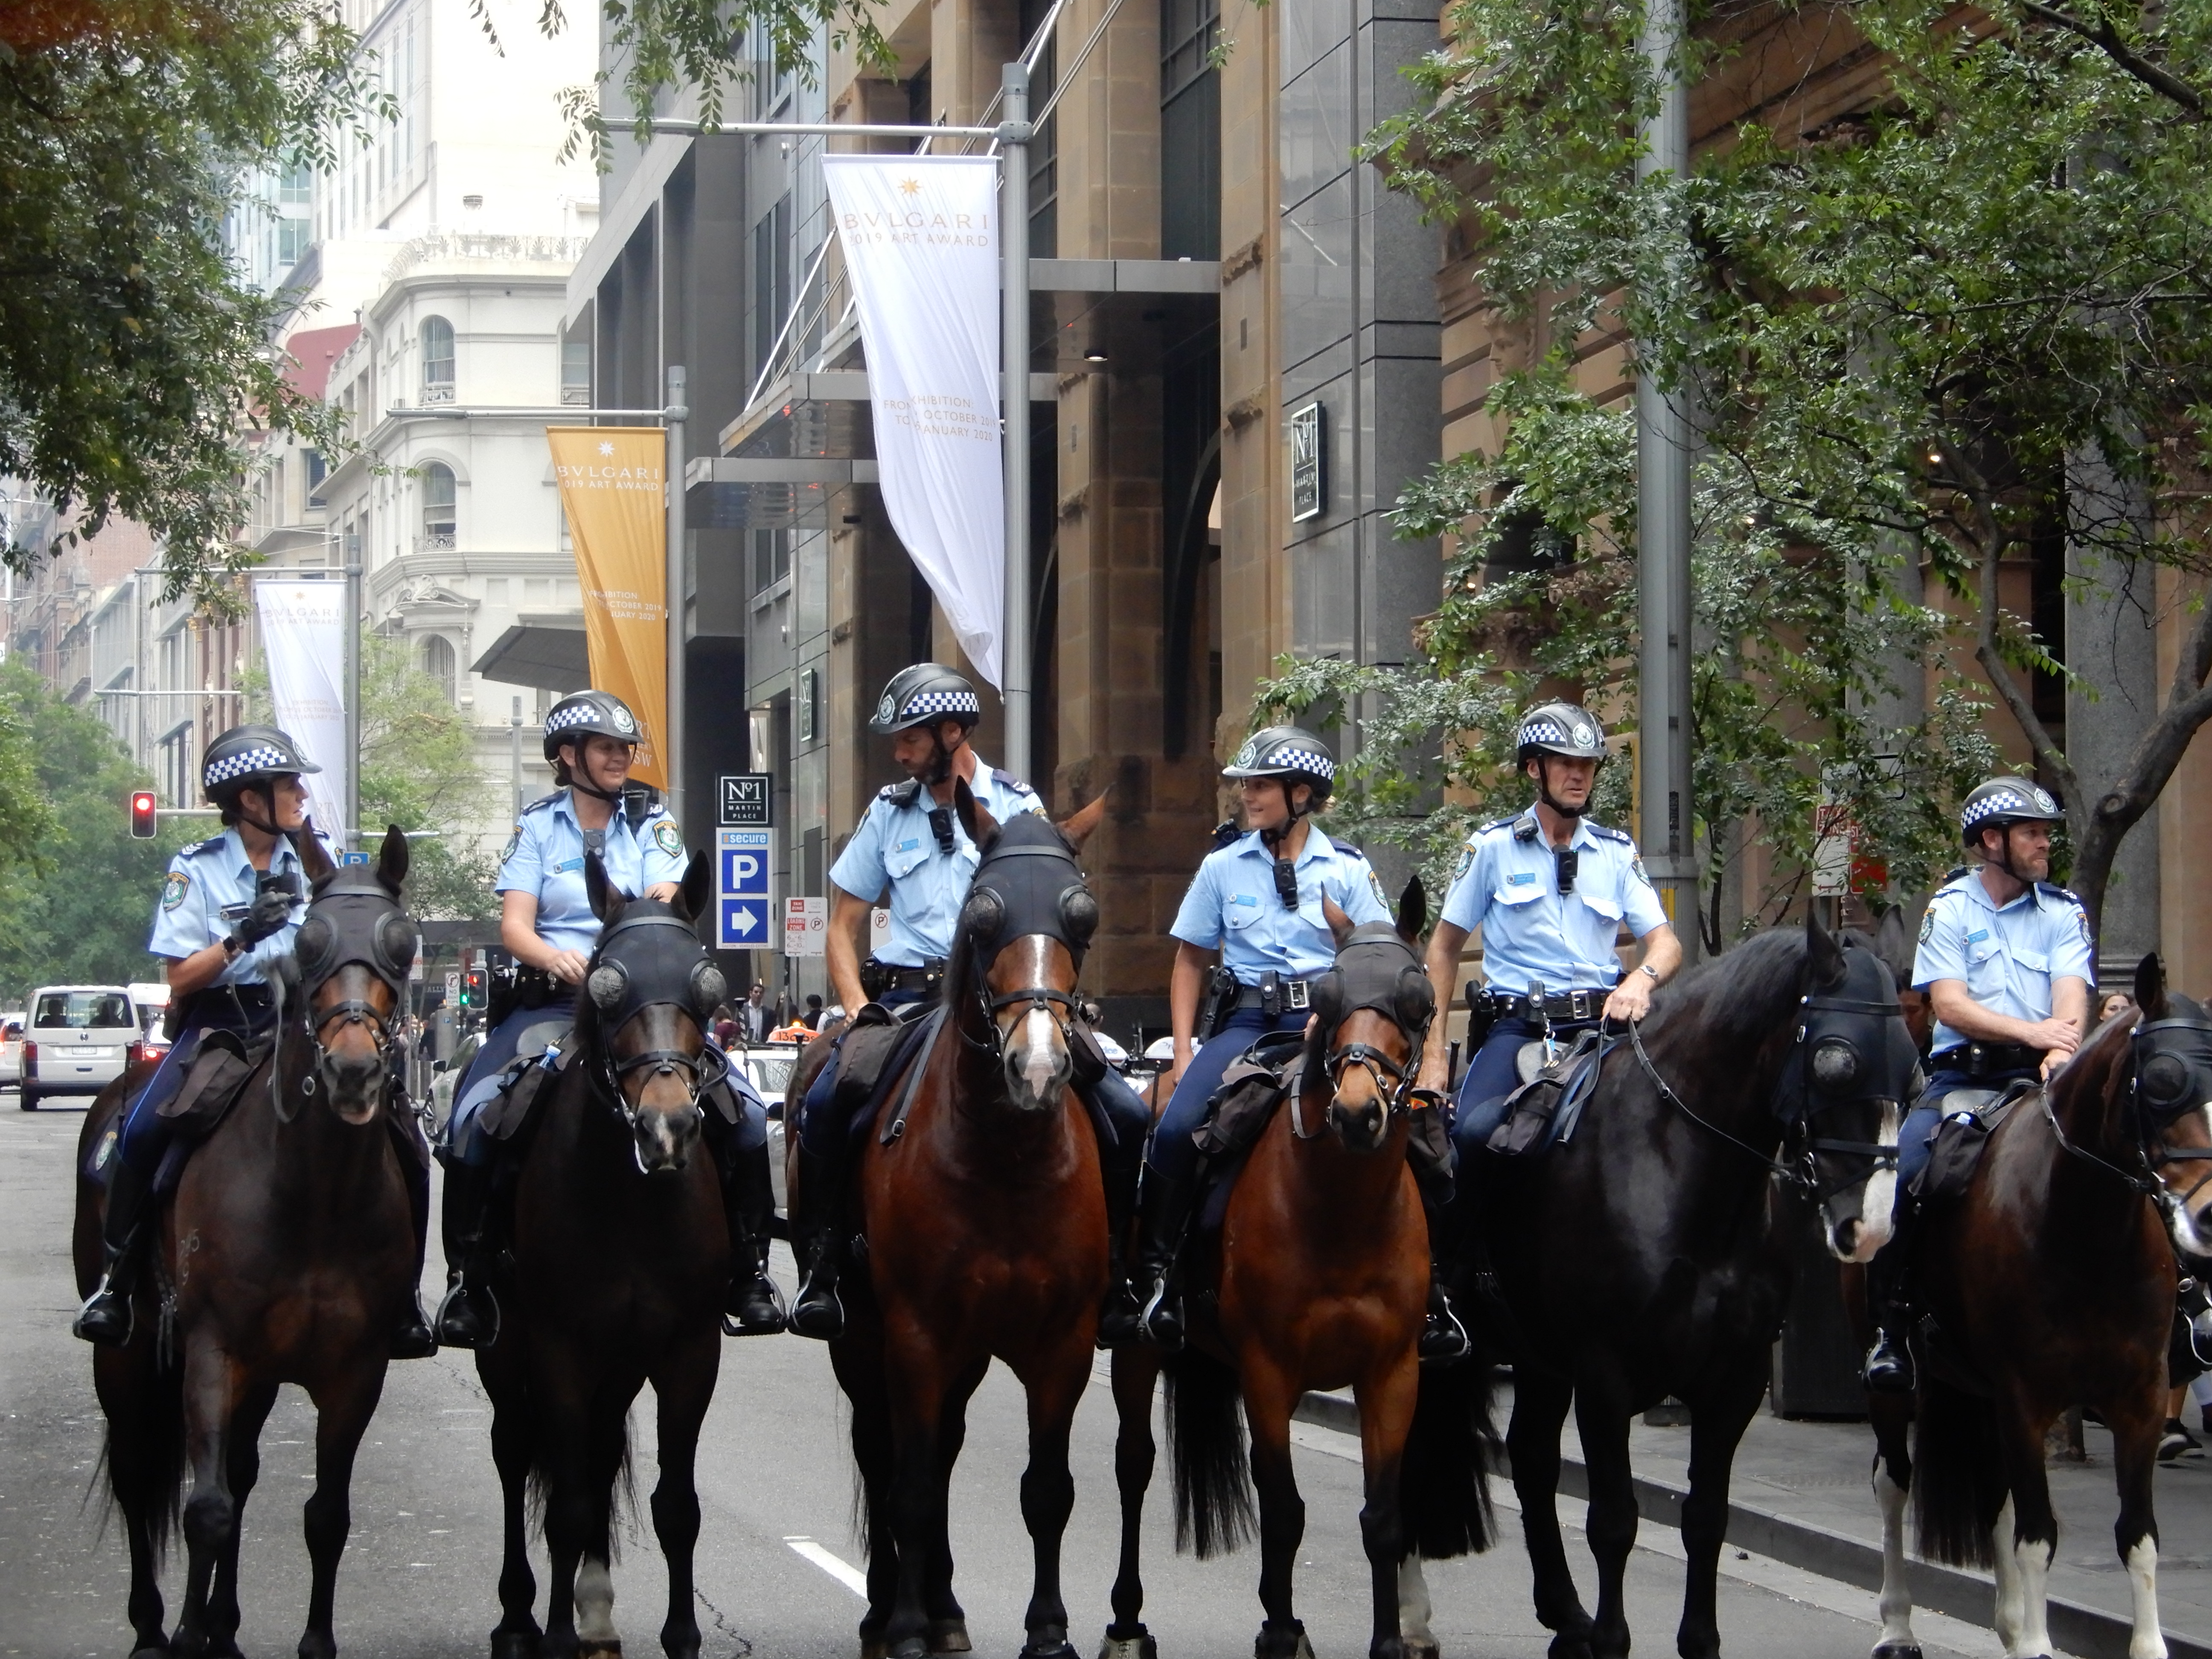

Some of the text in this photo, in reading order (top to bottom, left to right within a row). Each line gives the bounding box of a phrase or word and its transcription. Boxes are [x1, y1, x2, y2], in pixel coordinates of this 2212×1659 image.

[844, 212, 988, 230] BVLGARI
[891, 233, 919, 244] ART
[927, 234, 989, 247] AWARD
[911, 395, 971, 408] XHIBITION
[895, 415, 910, 425] TO
[924, 410, 977, 424] OCTOBER
[923, 424, 969, 437] ANUARY
[974, 429, 993, 442] 2020
[558, 466, 658, 479] BVLGARI
[565, 480, 658, 491] 019 ART AWARD
[1299, 491, 1312, 505] PLACE
[609, 601, 642, 610] CTOBER
[266, 608, 340, 618] BVLGARI
[639, 612, 656, 621] 2020
[730, 834, 766, 843] secure
[733, 855, 759, 889] P
